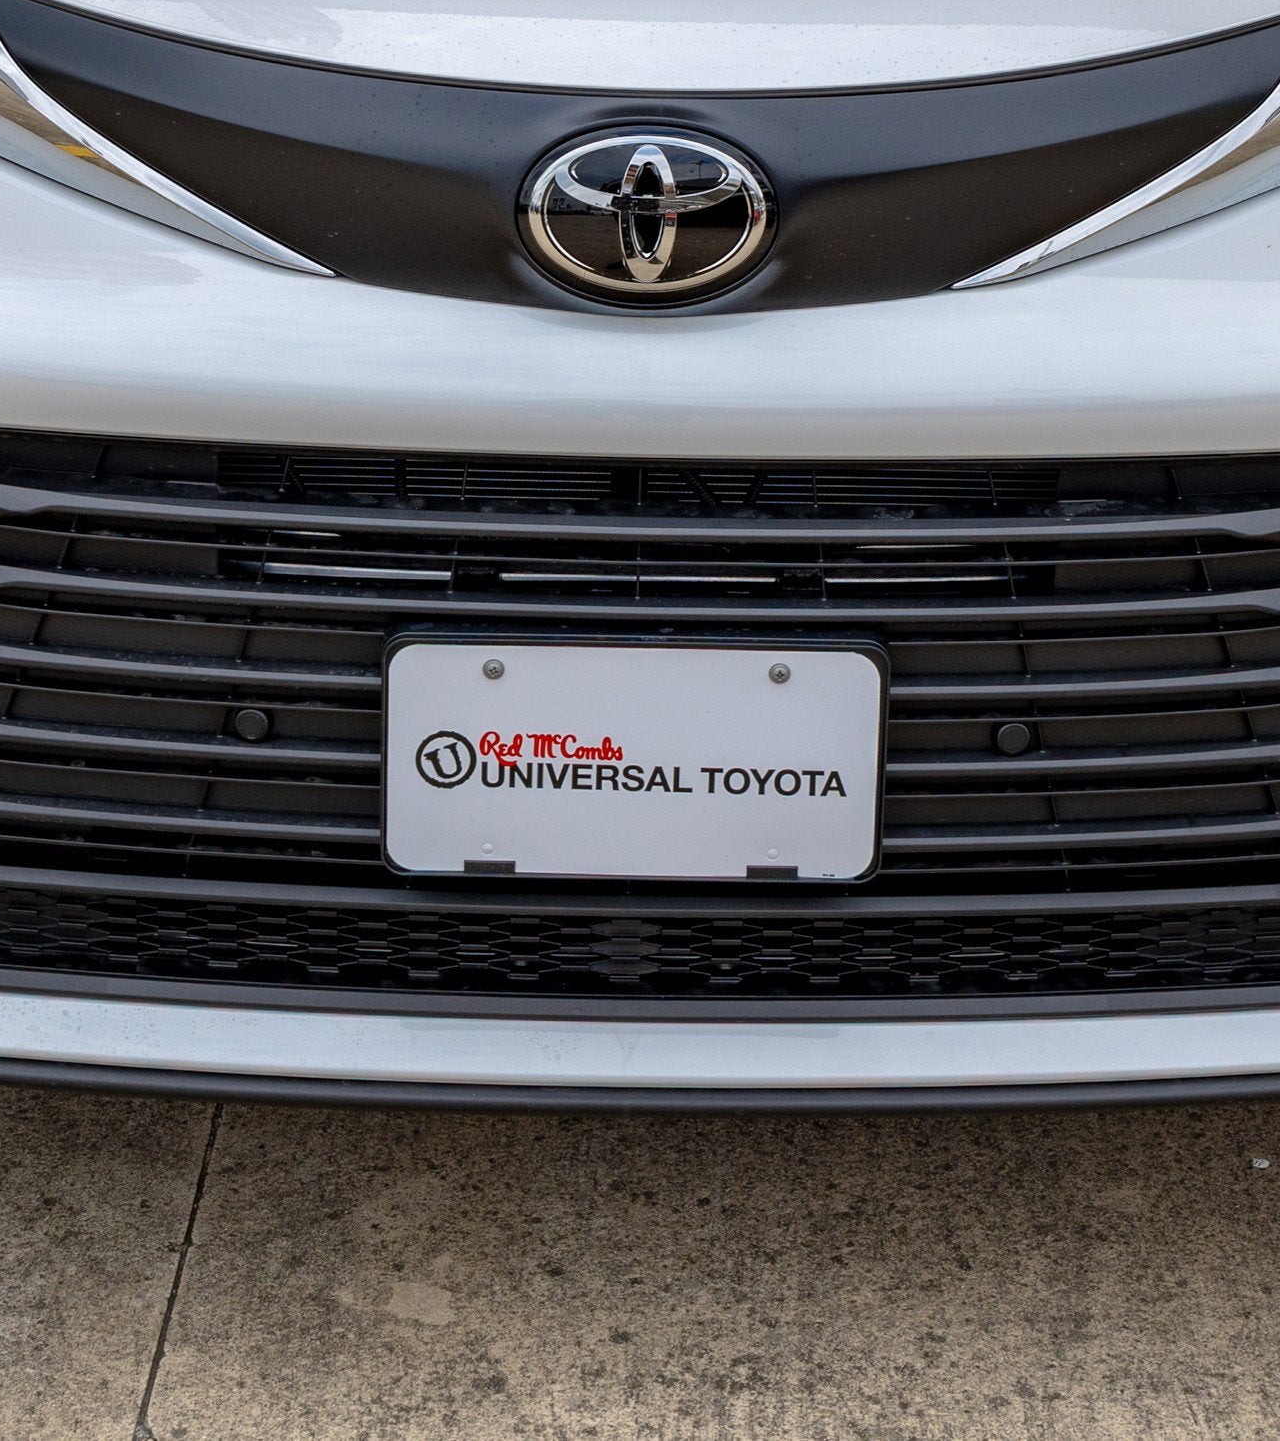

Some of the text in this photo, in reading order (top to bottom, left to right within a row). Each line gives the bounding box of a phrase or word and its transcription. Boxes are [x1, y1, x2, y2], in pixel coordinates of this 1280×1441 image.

[480, 731, 522, 766] Red
[481, 761, 848, 798] UNIVERSAL TOYOTA
